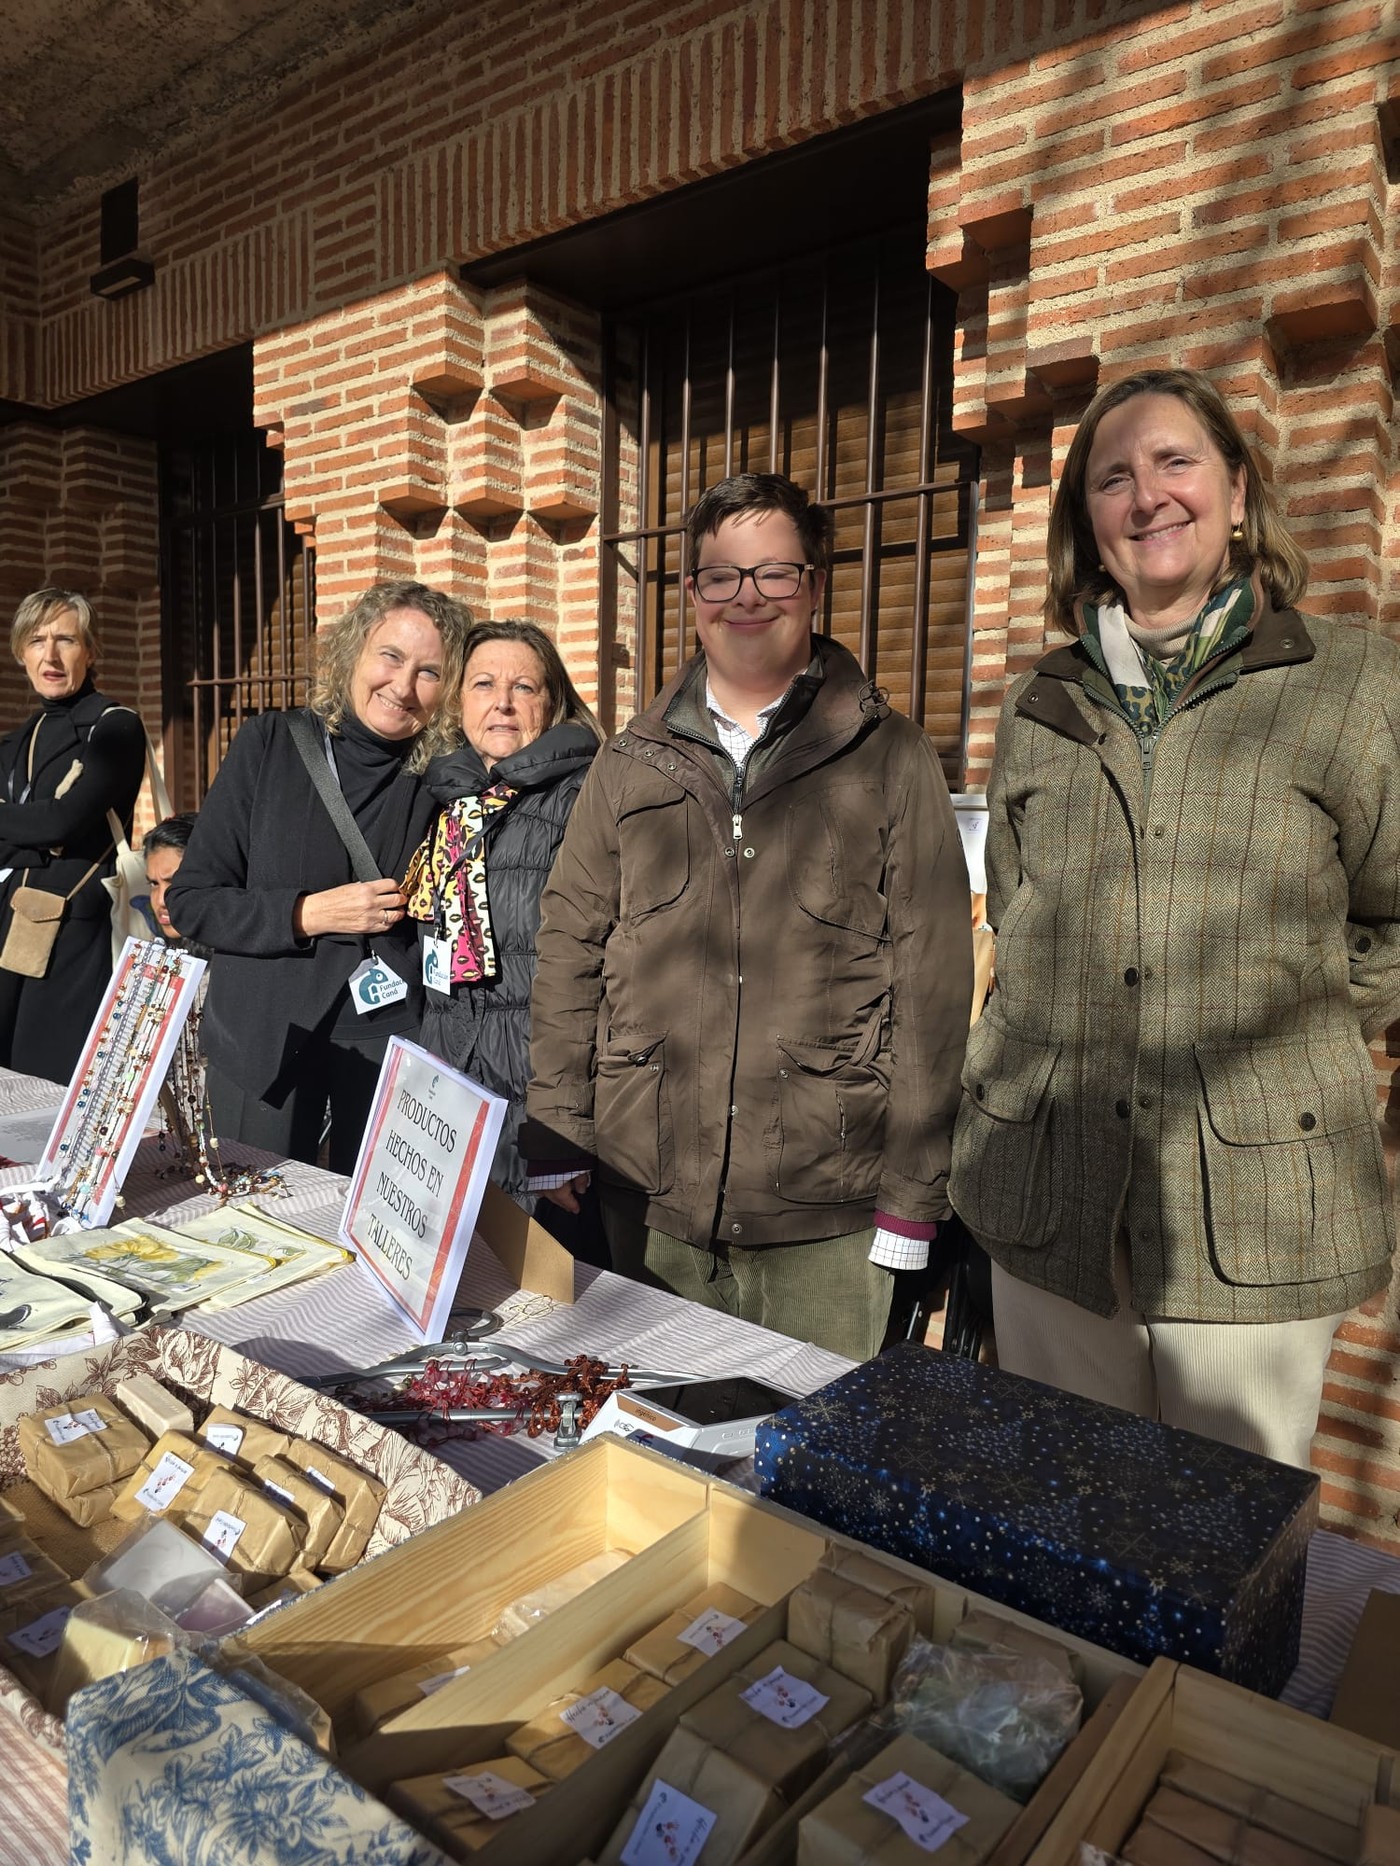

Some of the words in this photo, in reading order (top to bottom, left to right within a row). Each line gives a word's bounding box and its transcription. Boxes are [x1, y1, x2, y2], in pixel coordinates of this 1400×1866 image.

[396, 1089, 457, 1153] PRODUCTOS
[385, 1129, 427, 1181] HECHOS
[426, 1165, 444, 1198] EN
[376, 1171, 428, 1239] NUESTROS
[367, 1214, 413, 1281] TALLERES
[635, 1407, 657, 1422] ingenico
